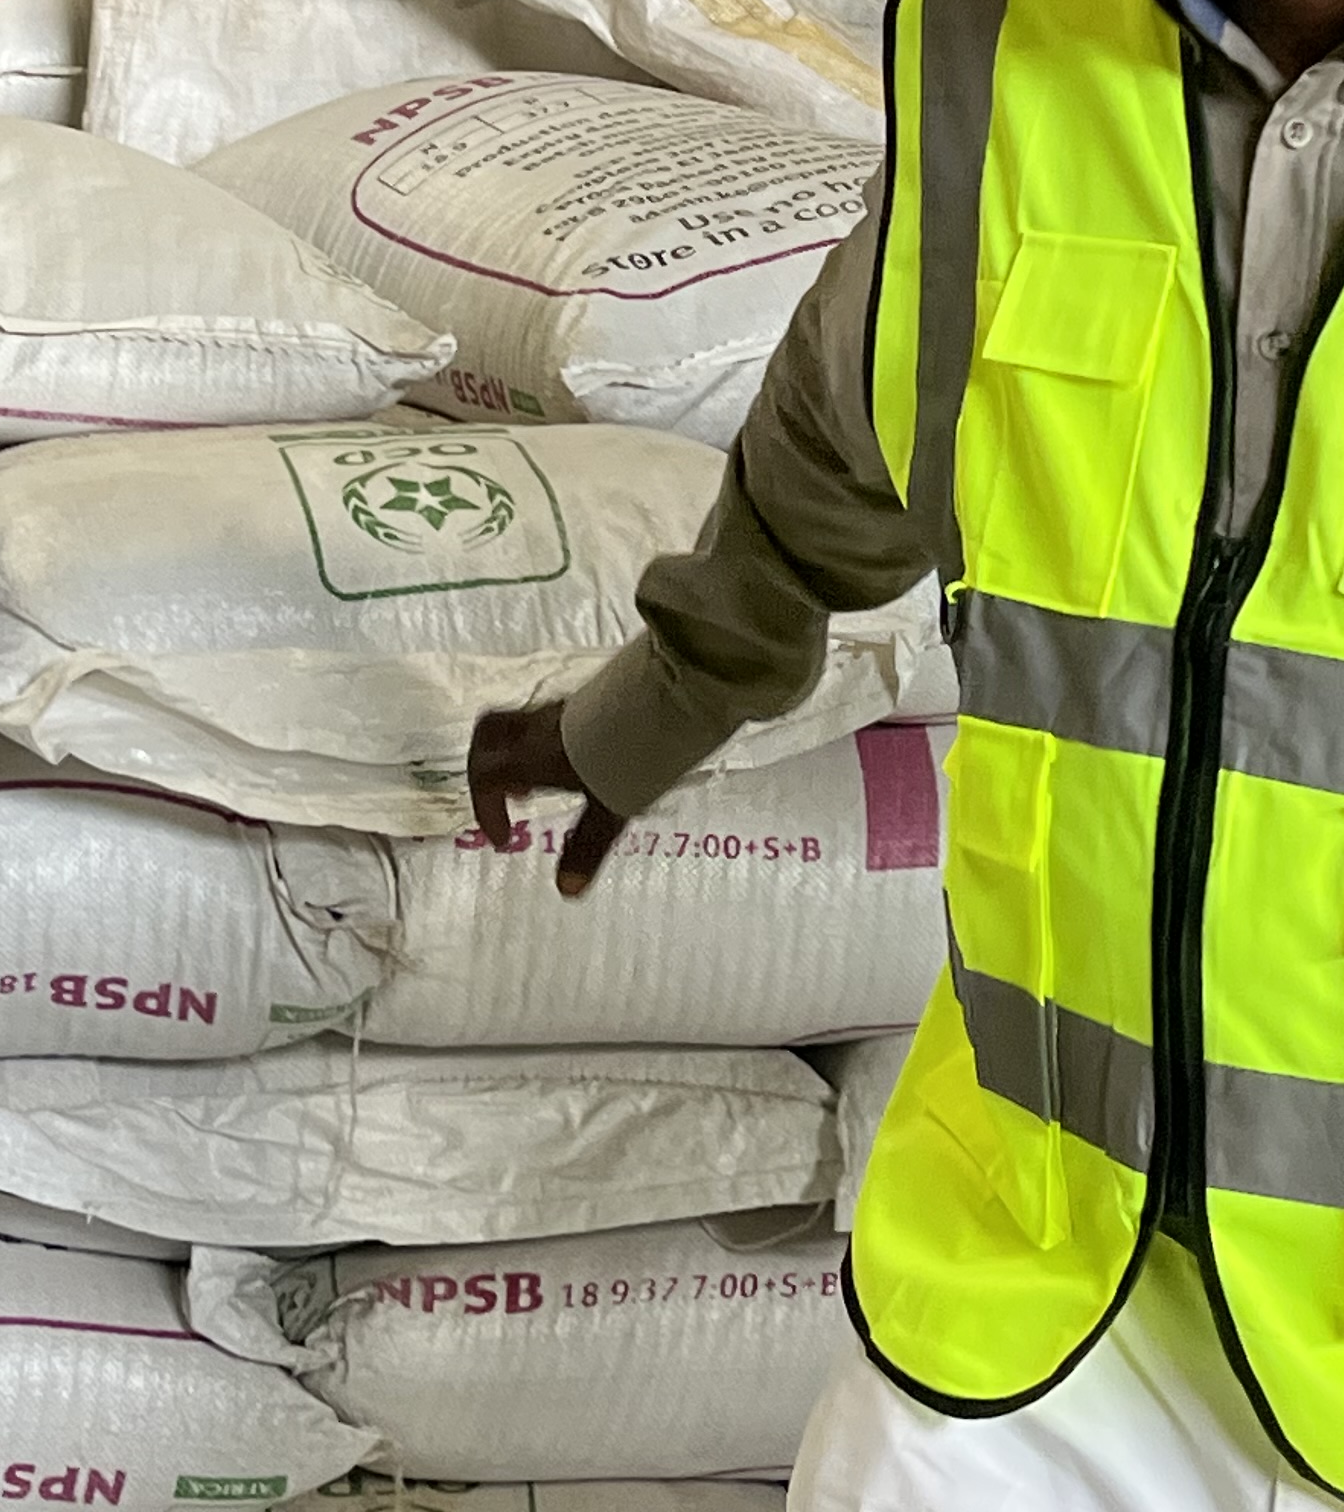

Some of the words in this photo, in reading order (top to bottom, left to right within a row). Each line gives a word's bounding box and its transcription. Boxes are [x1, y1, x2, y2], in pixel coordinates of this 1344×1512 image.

[351, 76, 515, 145] NPSB
[701, 224, 750, 247] in
[759, 219, 787, 234] a
[450, 368, 512, 416] NPSB
[333, 442, 478, 466] OCP
[50, 974, 218, 1025] NPSB
[373, 1273, 544, 1315] NPSB
